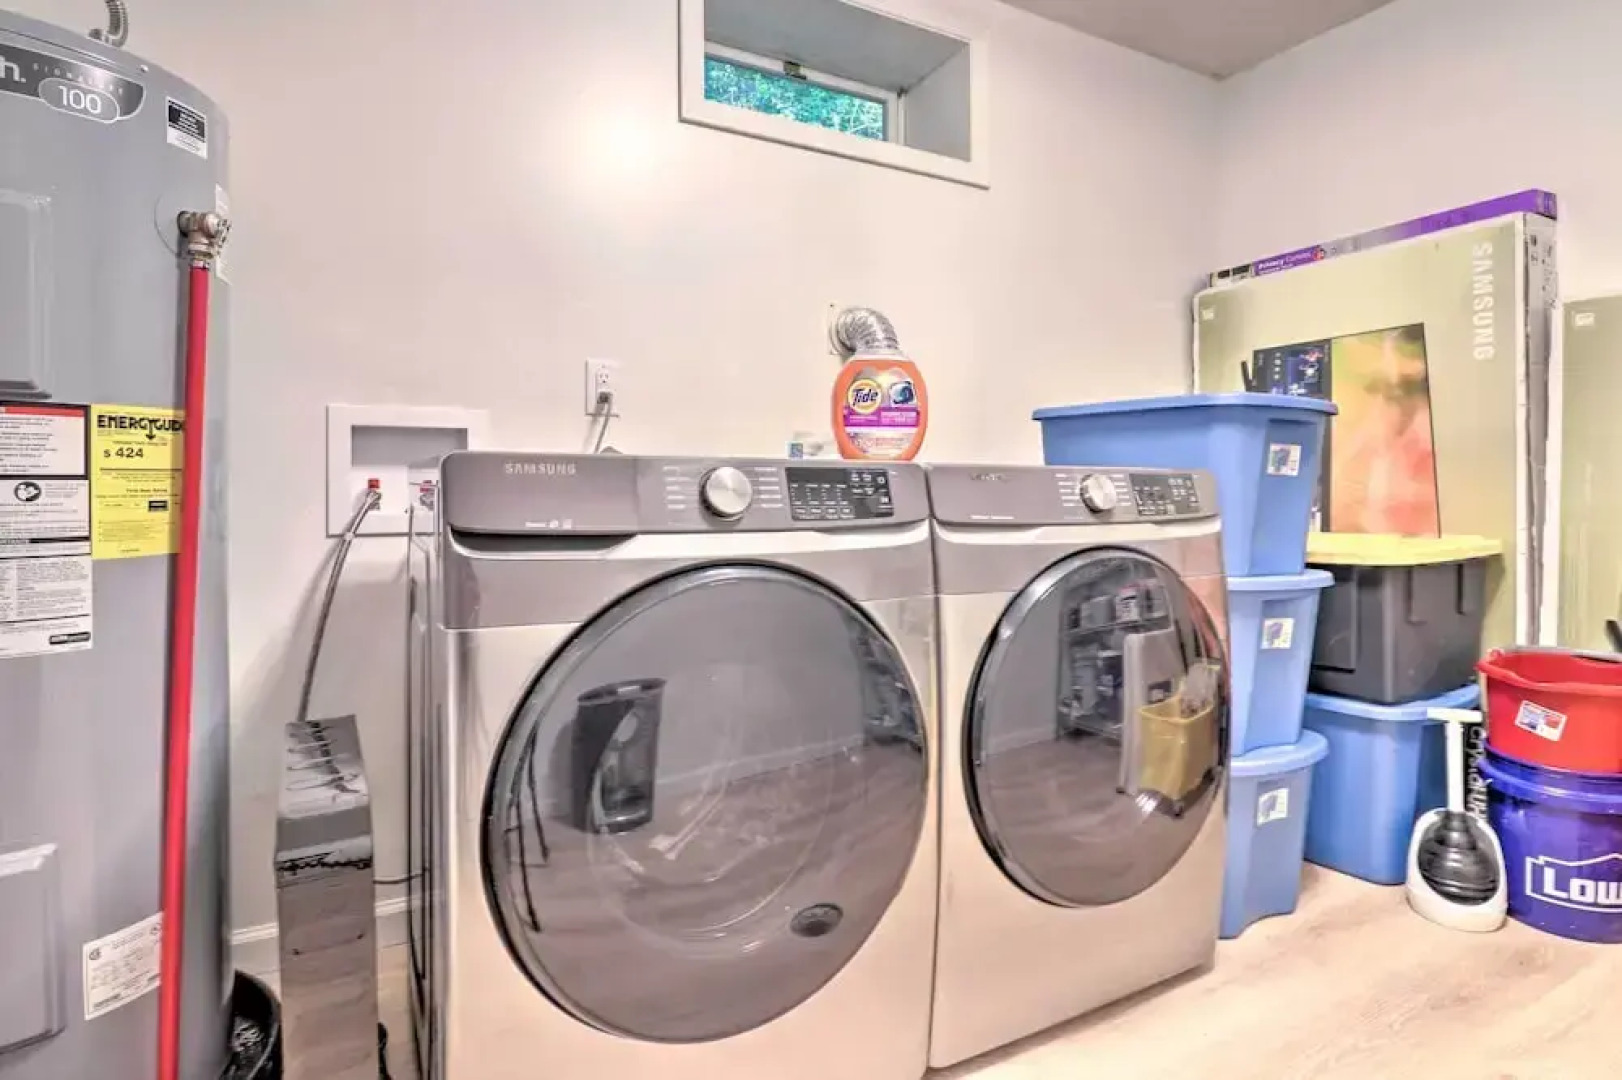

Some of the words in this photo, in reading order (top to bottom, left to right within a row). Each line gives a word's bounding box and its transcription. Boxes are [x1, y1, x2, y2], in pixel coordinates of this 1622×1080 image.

[58, 86, 101, 114] 100
[1473, 242, 1494, 360] SAMSUNG
[852, 388, 878, 406] Tide
[97, 414, 185, 435] ENERGYGUID
[115, 447, 144, 458] 424
[505, 463, 577, 476] SAMSUNG
